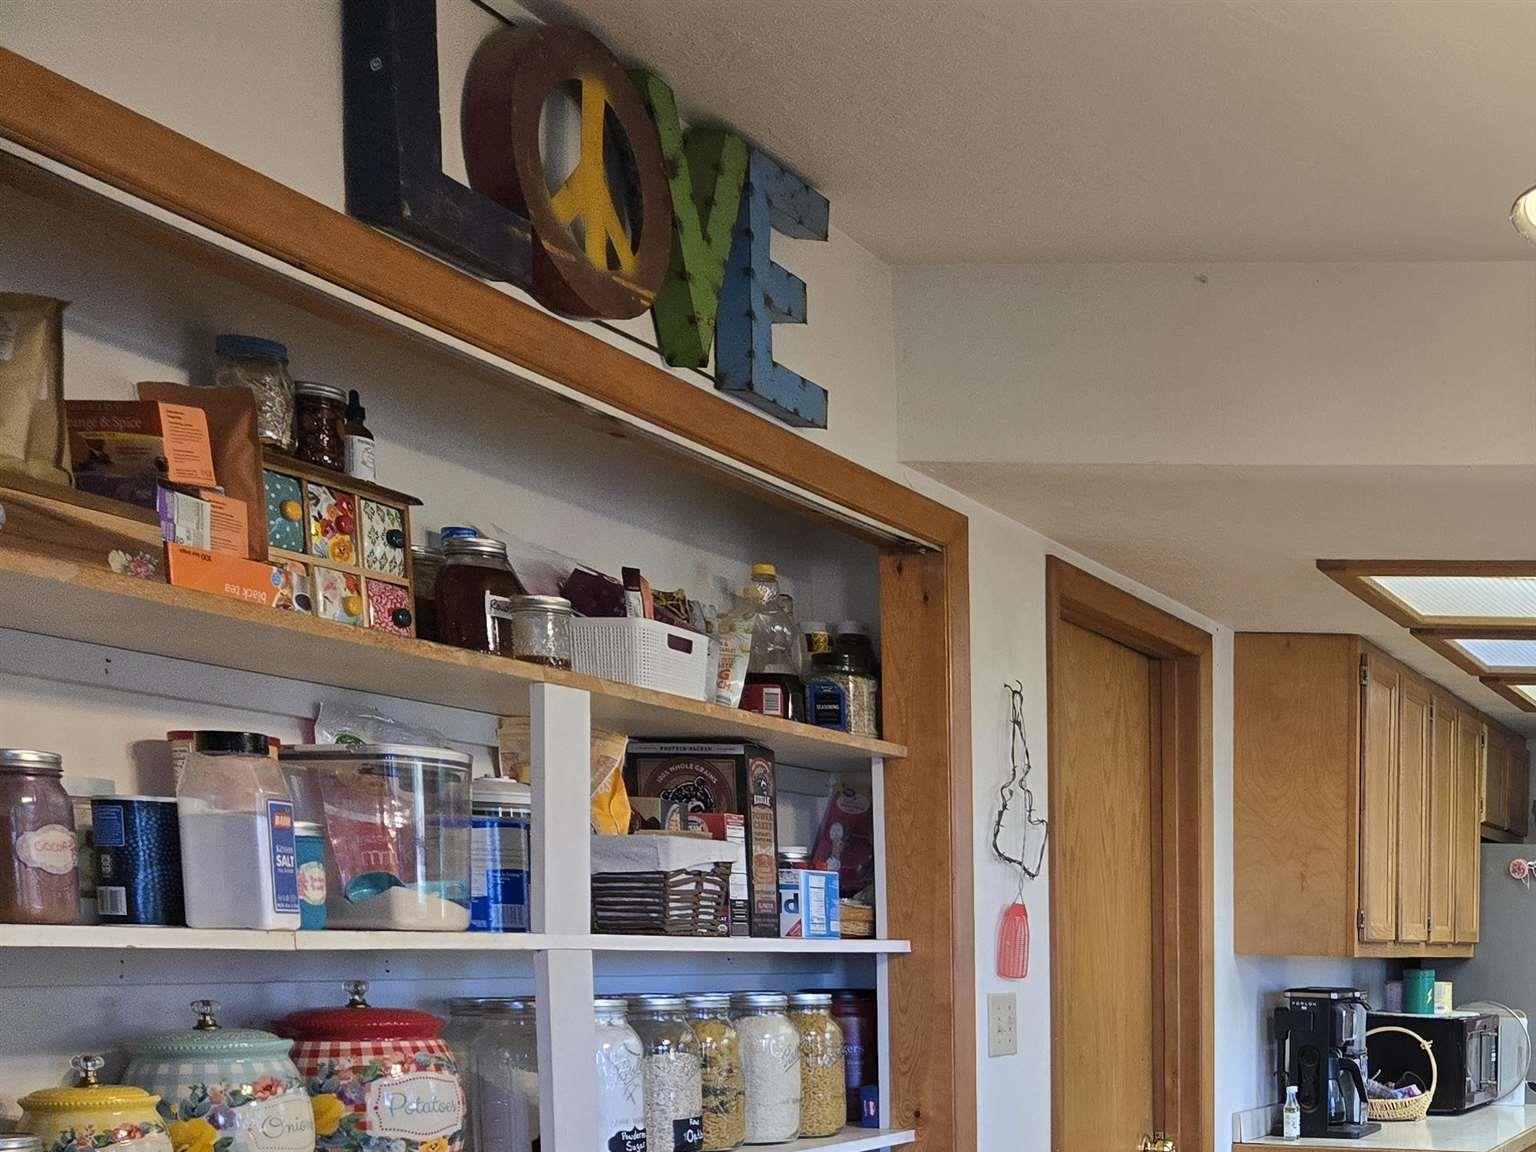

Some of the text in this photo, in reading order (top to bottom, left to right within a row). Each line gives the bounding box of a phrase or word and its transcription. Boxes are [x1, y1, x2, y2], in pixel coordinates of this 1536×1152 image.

[343, 0, 830, 430] LOVE
[223, 582, 268, 604] black tea
[670, 762, 694, 773] WHOLE
[694, 763, 718, 784] GRAINS
[275, 855, 295, 868] SALT
[384, 1094, 458, 1118] Potatoes
